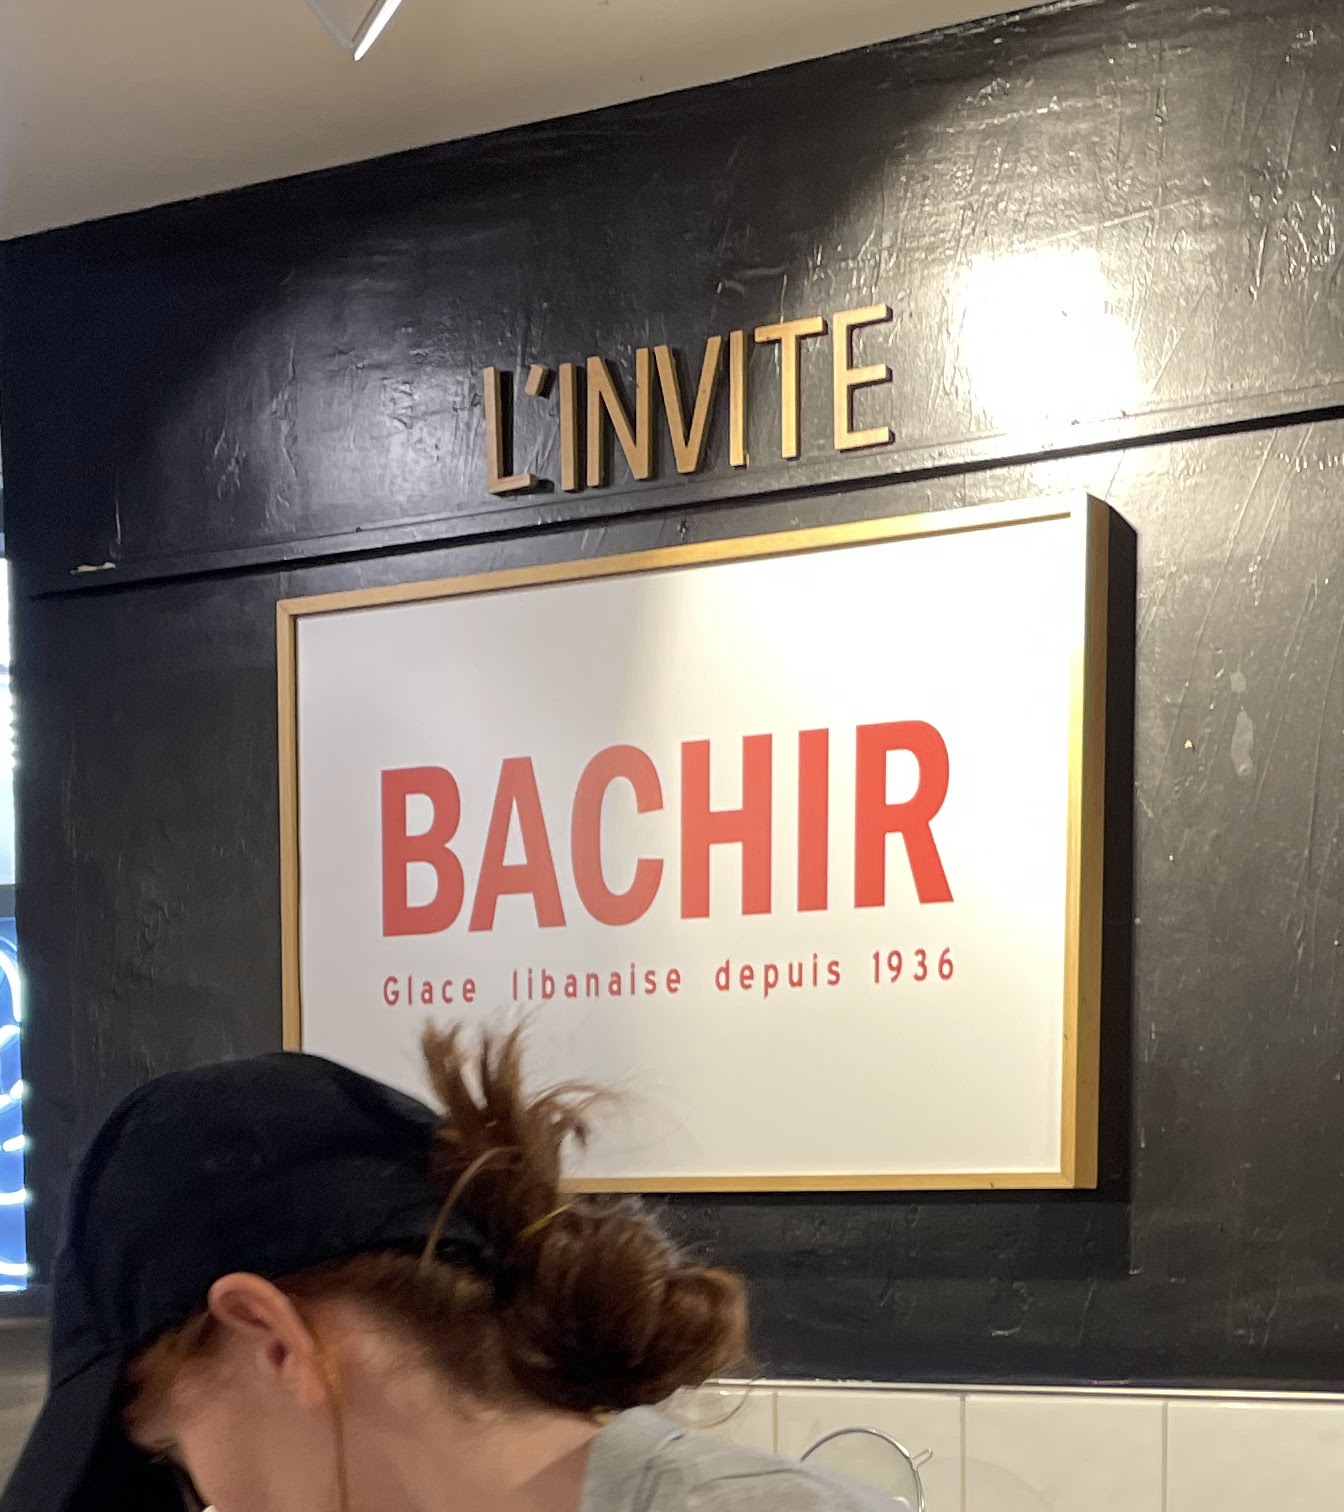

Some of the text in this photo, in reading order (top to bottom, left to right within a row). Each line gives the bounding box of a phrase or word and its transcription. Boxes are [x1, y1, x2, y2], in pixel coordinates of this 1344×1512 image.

[482, 303, 895, 496] L'INVITE
[380, 720, 955, 938] BACHIR
[382, 946, 953, 1007] Glace libanaise depuis 1936
